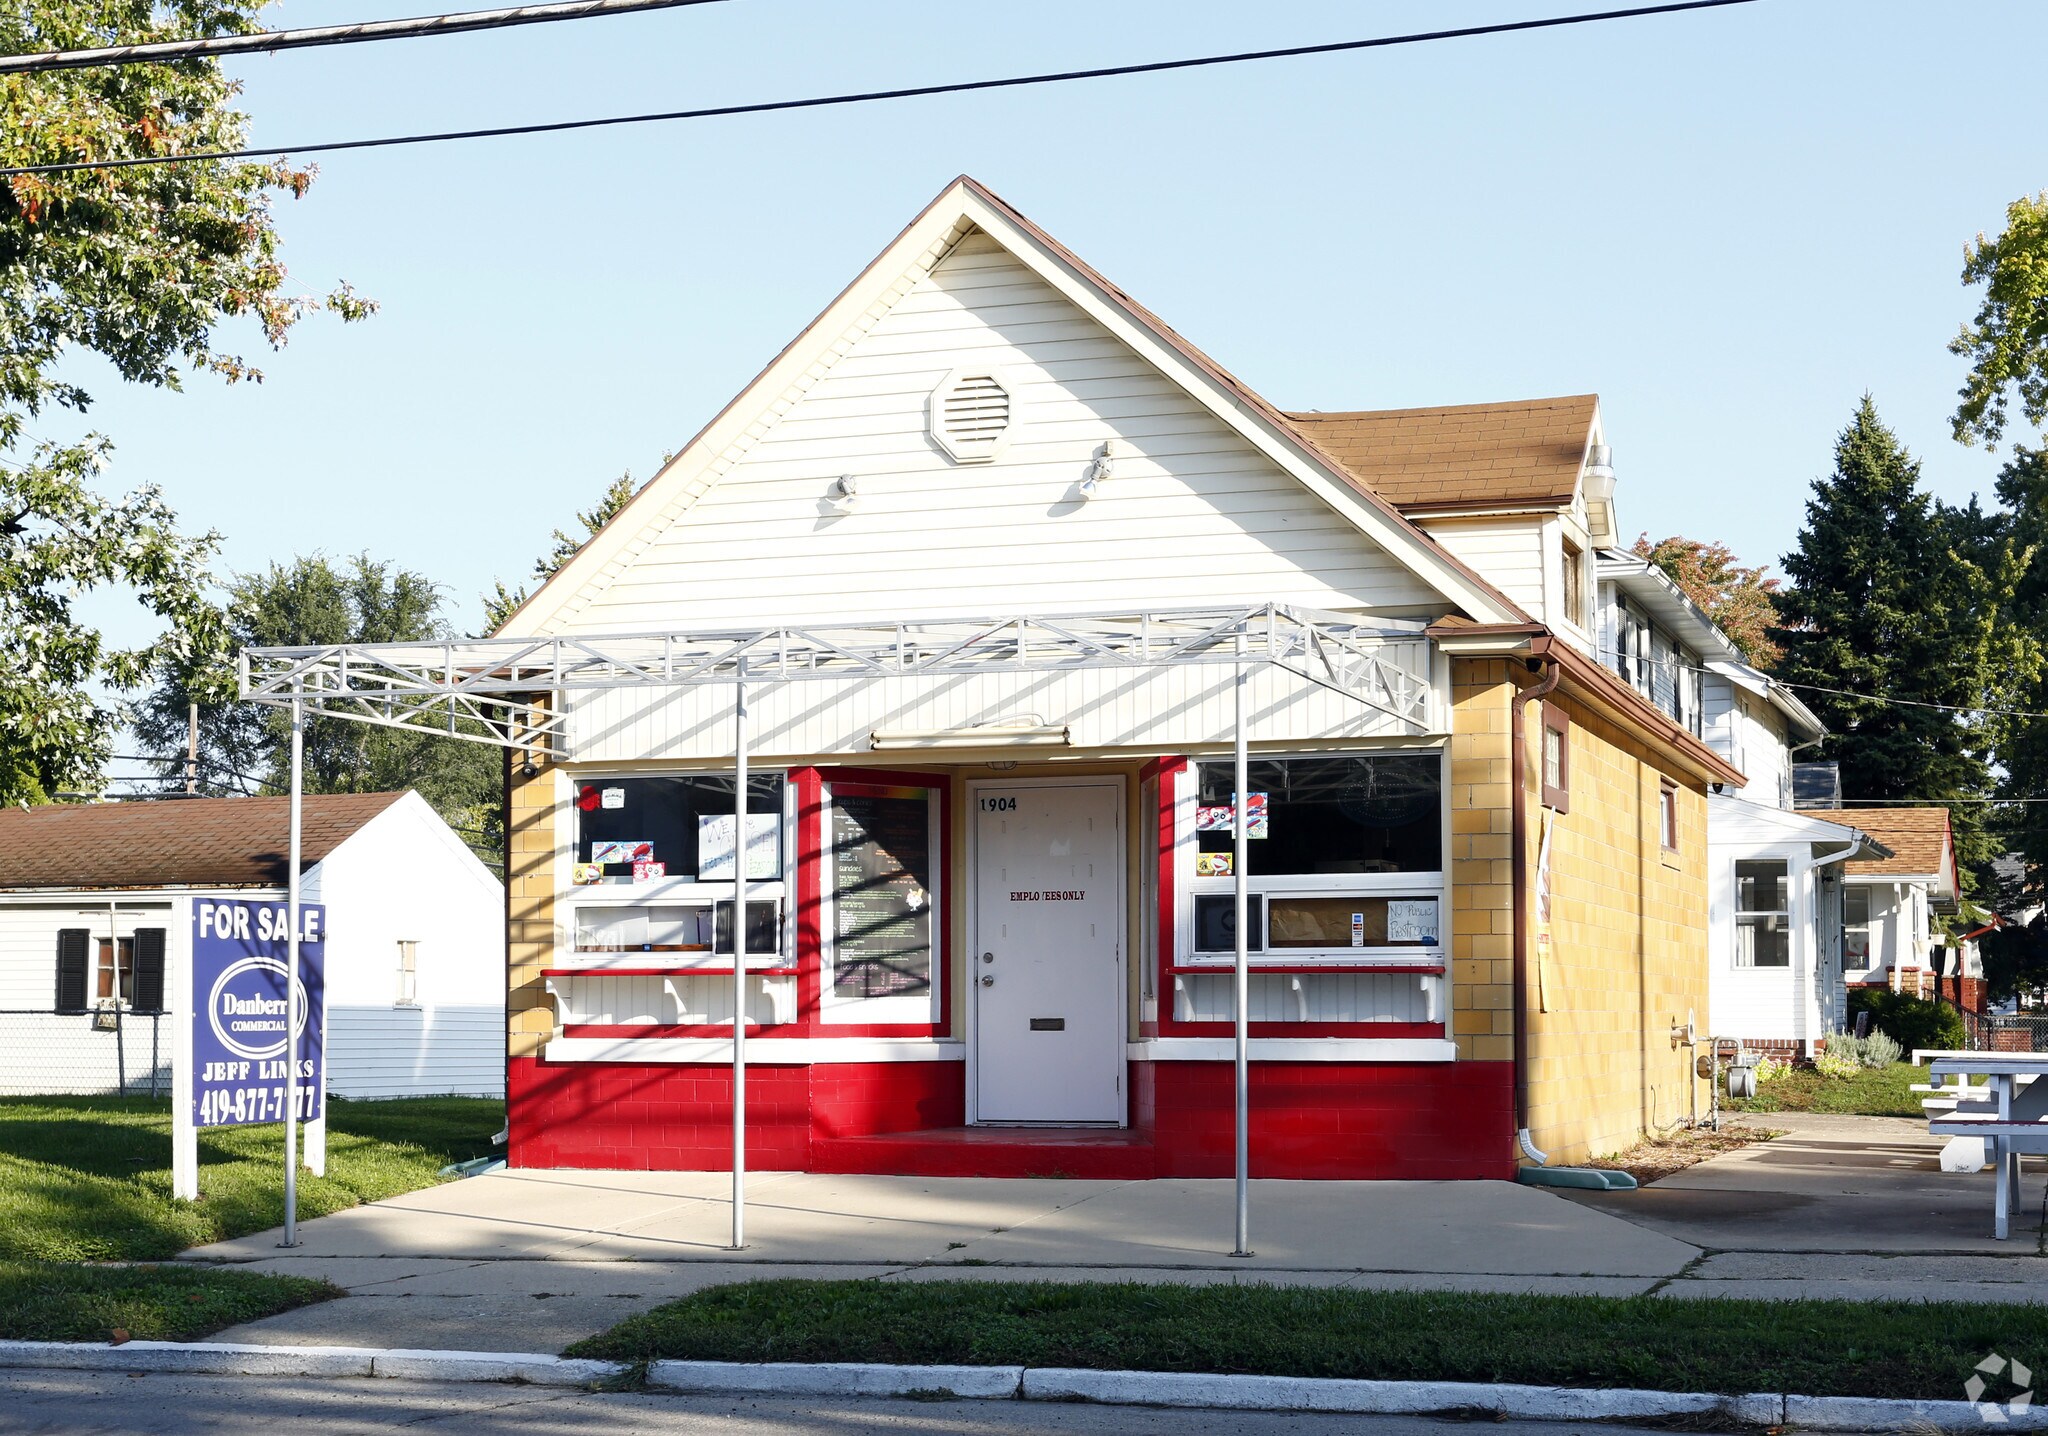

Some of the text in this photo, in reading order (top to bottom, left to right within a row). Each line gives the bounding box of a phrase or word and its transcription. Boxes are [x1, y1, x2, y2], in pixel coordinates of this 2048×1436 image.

[980, 797, 1017, 812] 1904
[1062, 890, 1085, 901] ONLY
[1389, 904, 1403, 918] NO
[200, 903, 251, 940] FOR
[231, 1020, 288, 1032] COMMERCIAL
[201, 1061, 251, 1082] JEFF
